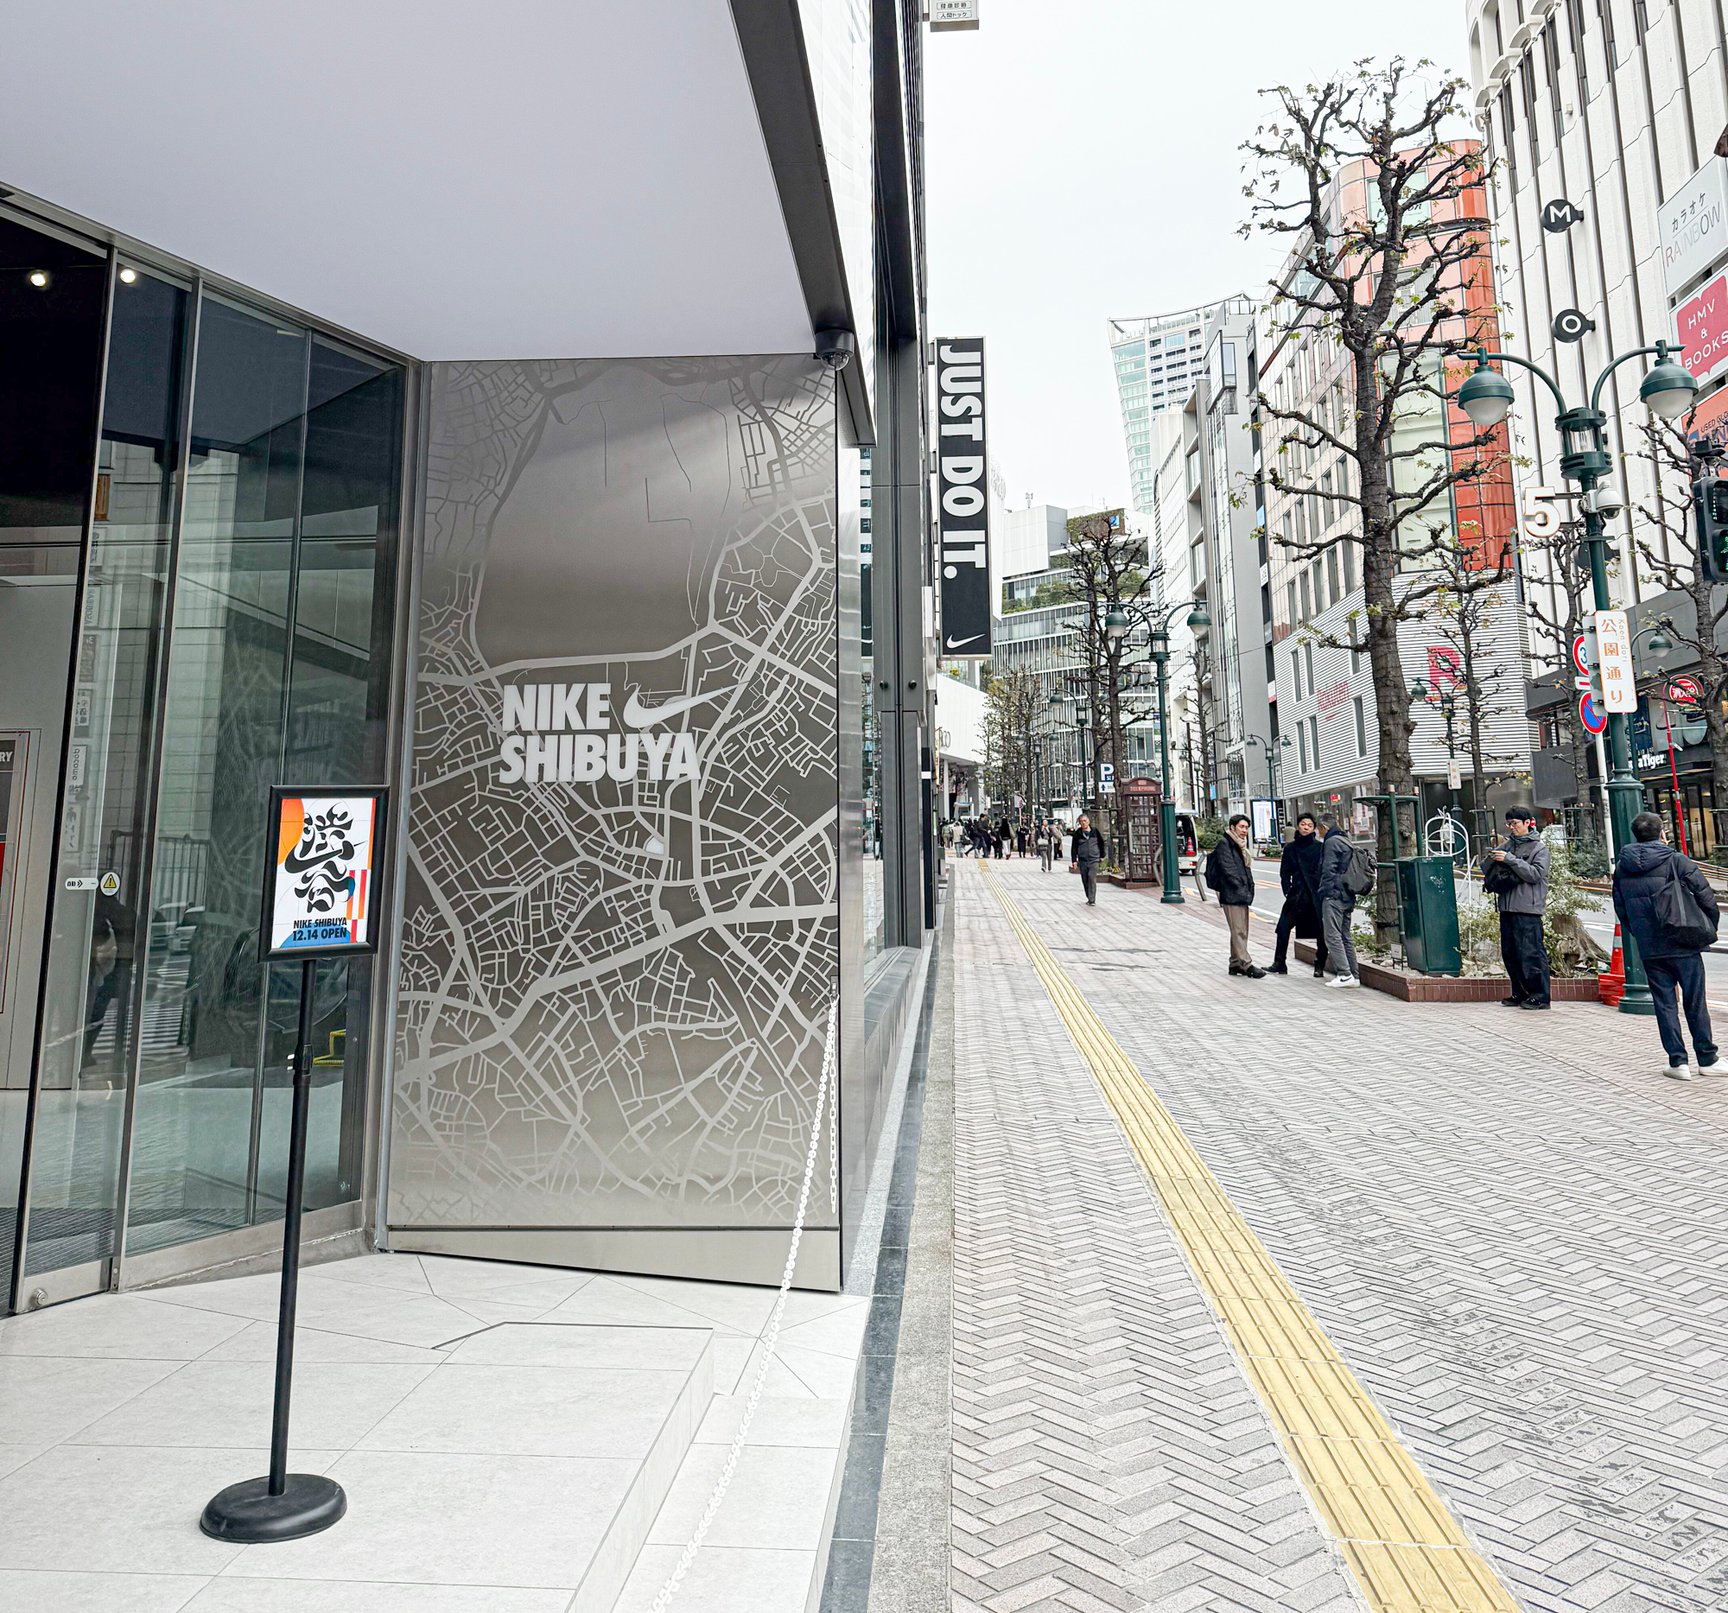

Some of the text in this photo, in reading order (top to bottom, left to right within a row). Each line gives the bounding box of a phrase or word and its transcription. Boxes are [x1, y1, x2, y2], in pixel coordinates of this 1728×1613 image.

[1549, 204, 1572, 223] M
[1672, 192, 1706, 233] カラオケ
[1664, 201, 1720, 268] RAINBOW
[1561, 315, 1582, 335] O
[1687, 298, 1716, 330] HMV
[1701, 328, 1708, 339] &
[1684, 330, 1728, 371] BOOKS
[940, 345, 987, 579] JUST DO IT.
[1523, 486, 1561, 538] 5
[1601, 618, 1623, 704] 公園通り
[501, 682, 612, 732] NIKE
[498, 732, 702, 784] SHIBUYA
[1100, 763, 1115, 781] P
[292, 927, 347, 941] 12.14 OPEN
[293, 917, 347, 929] NIKE SHIBUYA
